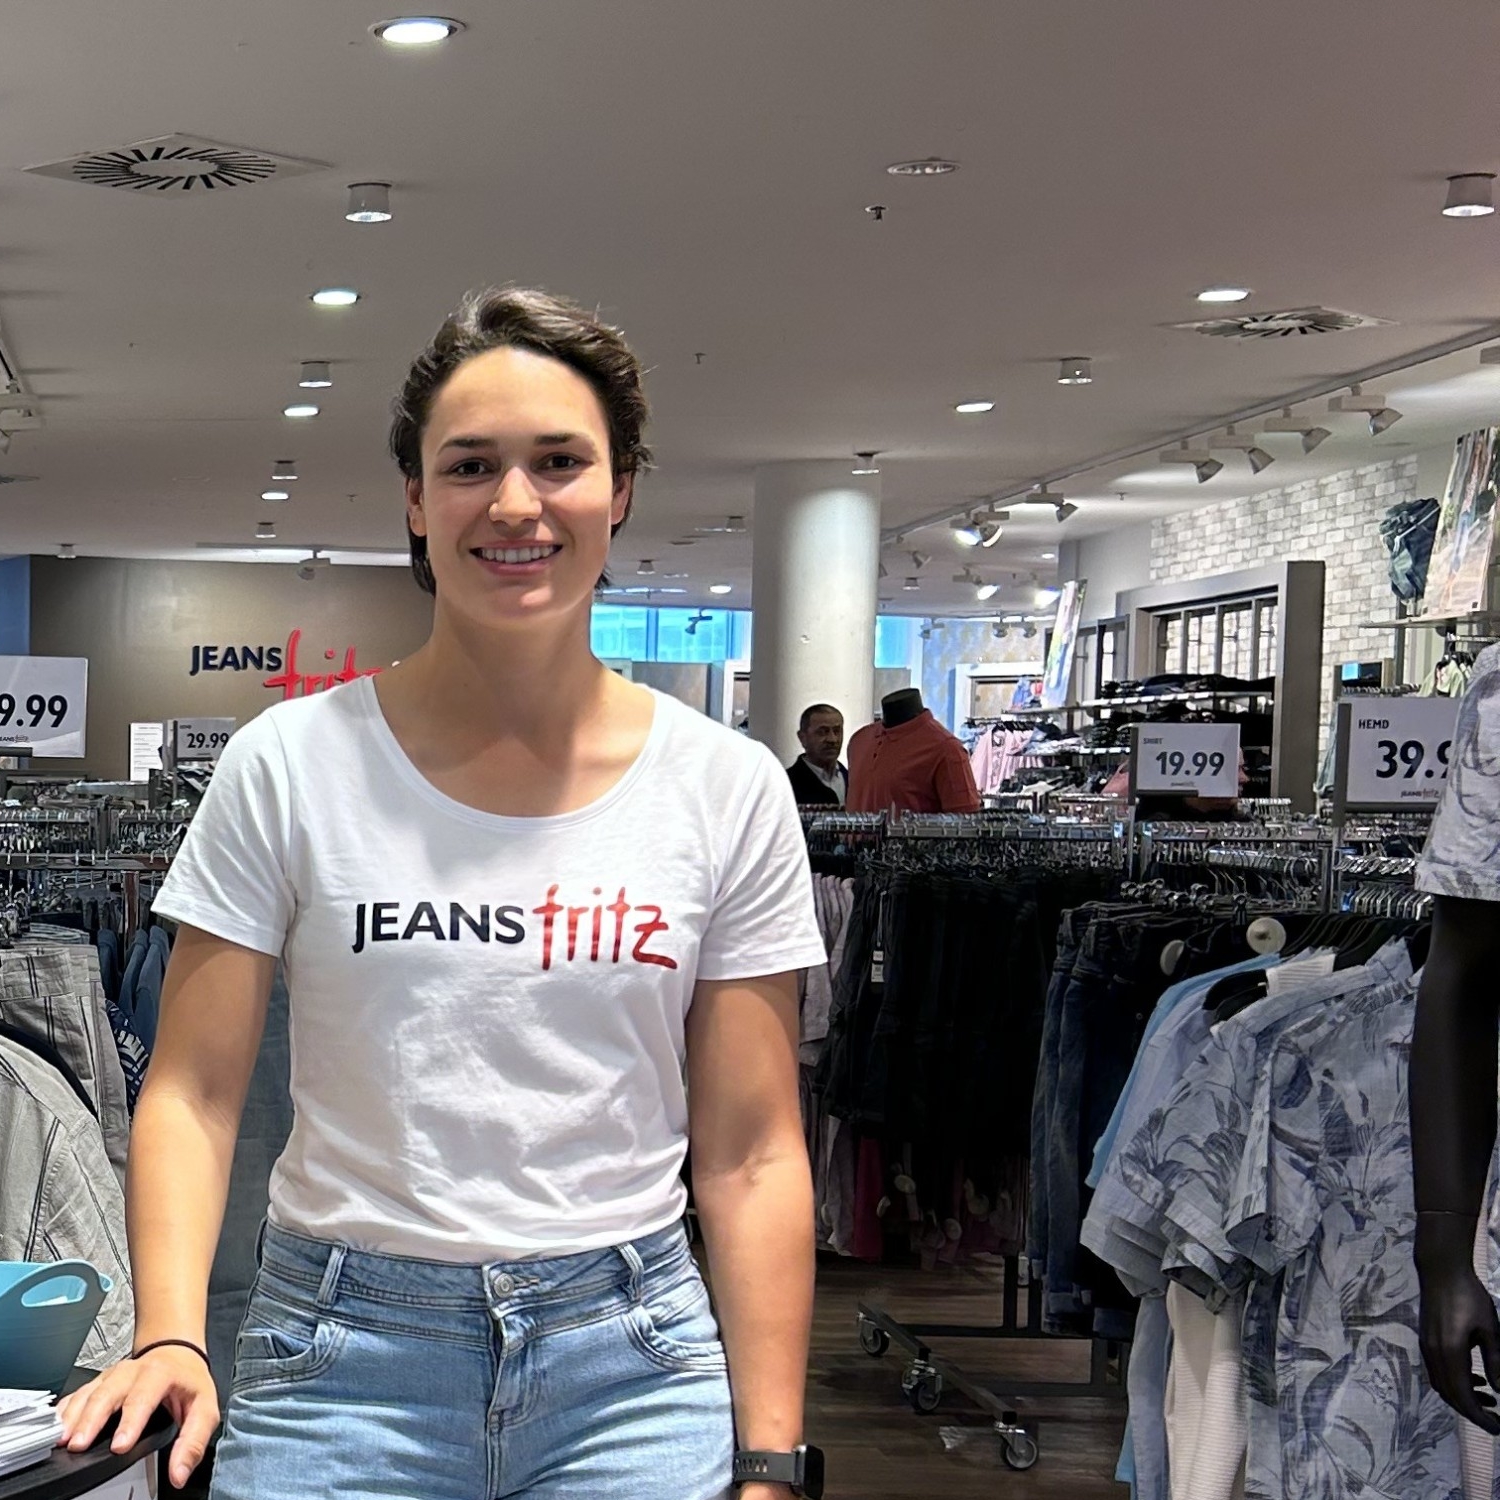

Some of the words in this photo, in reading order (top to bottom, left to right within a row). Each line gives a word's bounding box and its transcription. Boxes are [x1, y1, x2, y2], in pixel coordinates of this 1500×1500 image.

[189, 645, 283, 676] JEANS
[1358, 719, 1390, 730] HEMD
[187, 732, 230, 749] 29.99
[1156, 751, 1224, 776] 19.99
[1376, 740, 1452, 779] 39.9
[352, 901, 526, 954] JEANS
